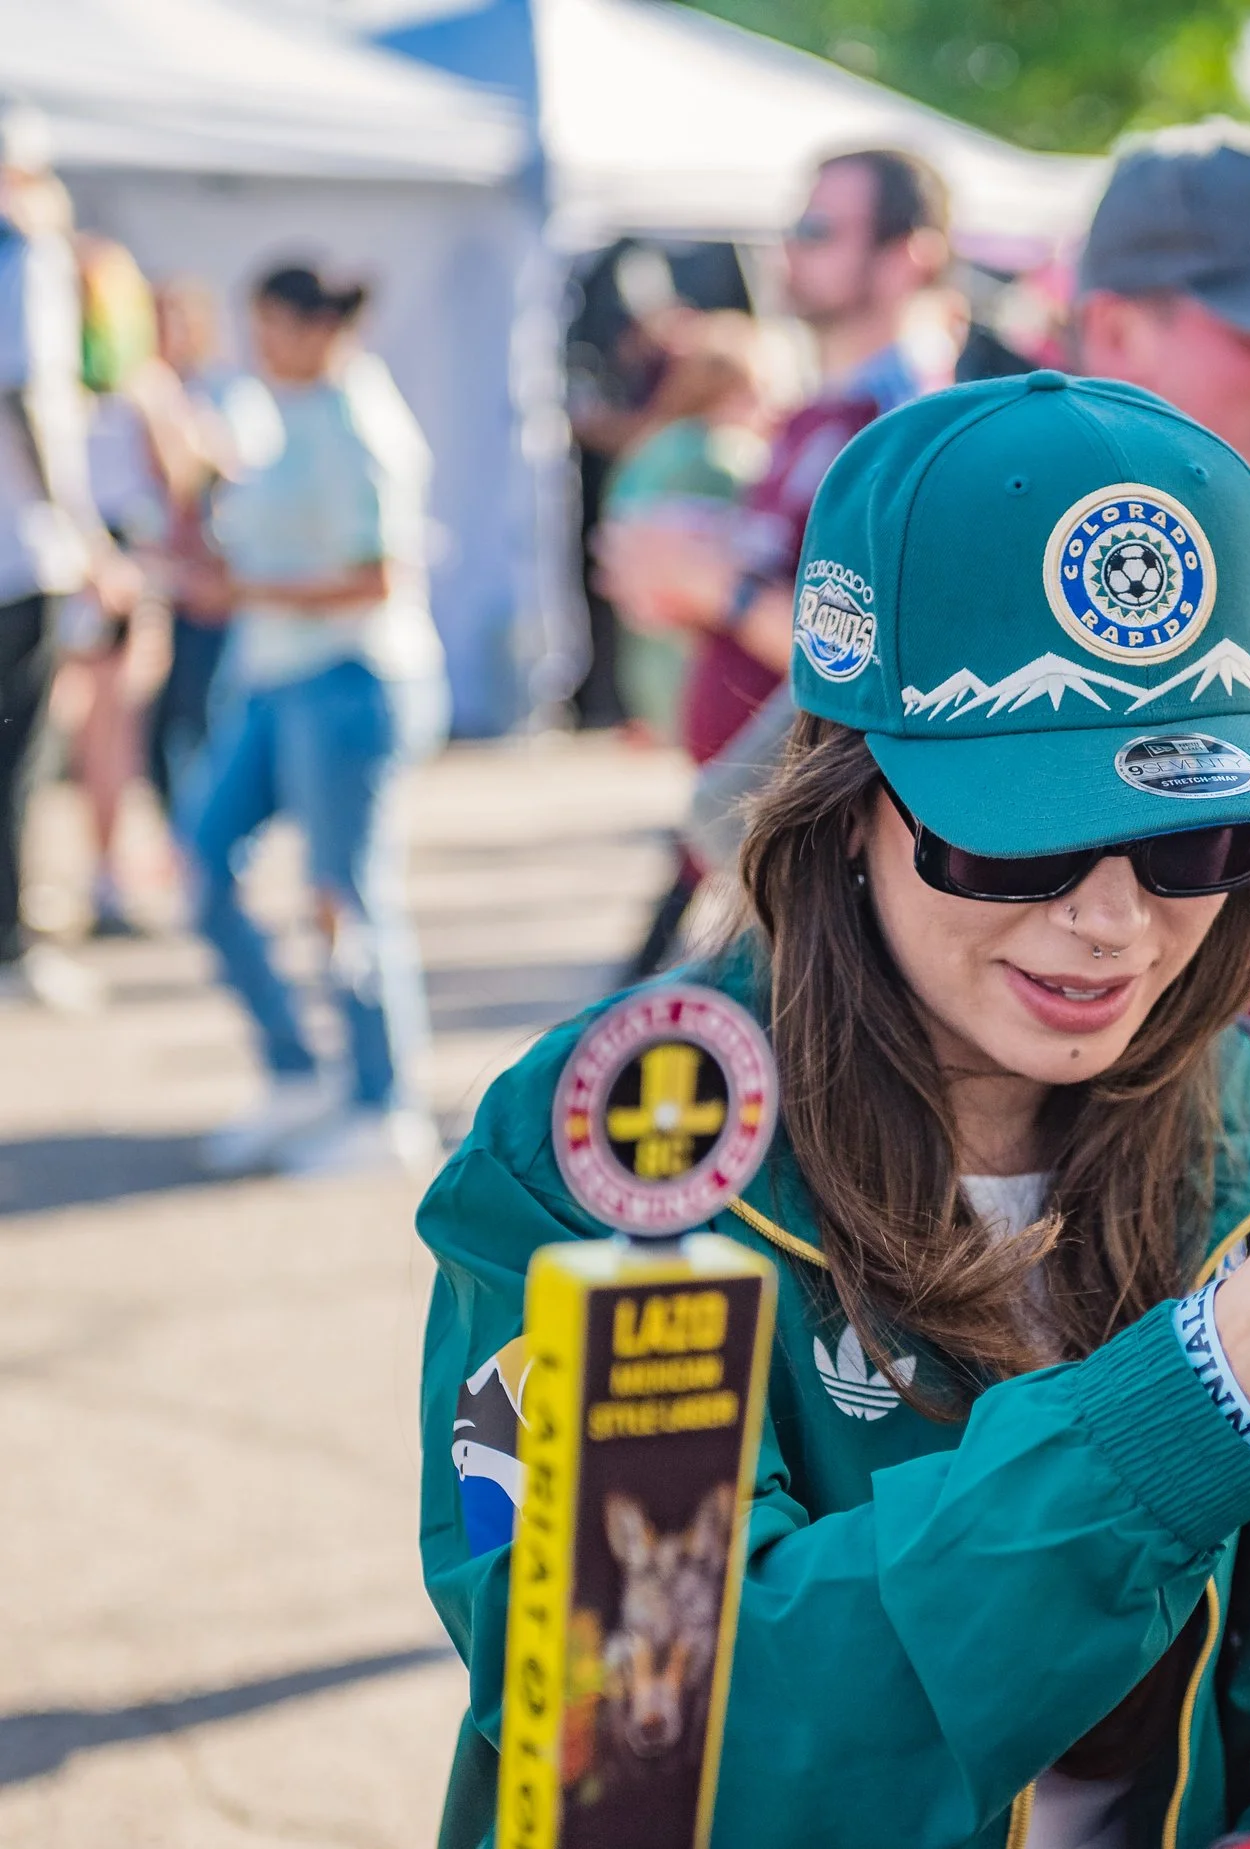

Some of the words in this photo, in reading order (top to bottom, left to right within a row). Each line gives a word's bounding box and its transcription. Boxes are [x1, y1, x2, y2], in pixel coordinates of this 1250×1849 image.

[1063, 503, 1198, 581] COLORADO
[1080, 601, 1194, 647] RAPIDS
[1128, 757, 1243, 776] 9SEVENTY
[1161, 775, 1239, 787] STRETCH-SNAP
